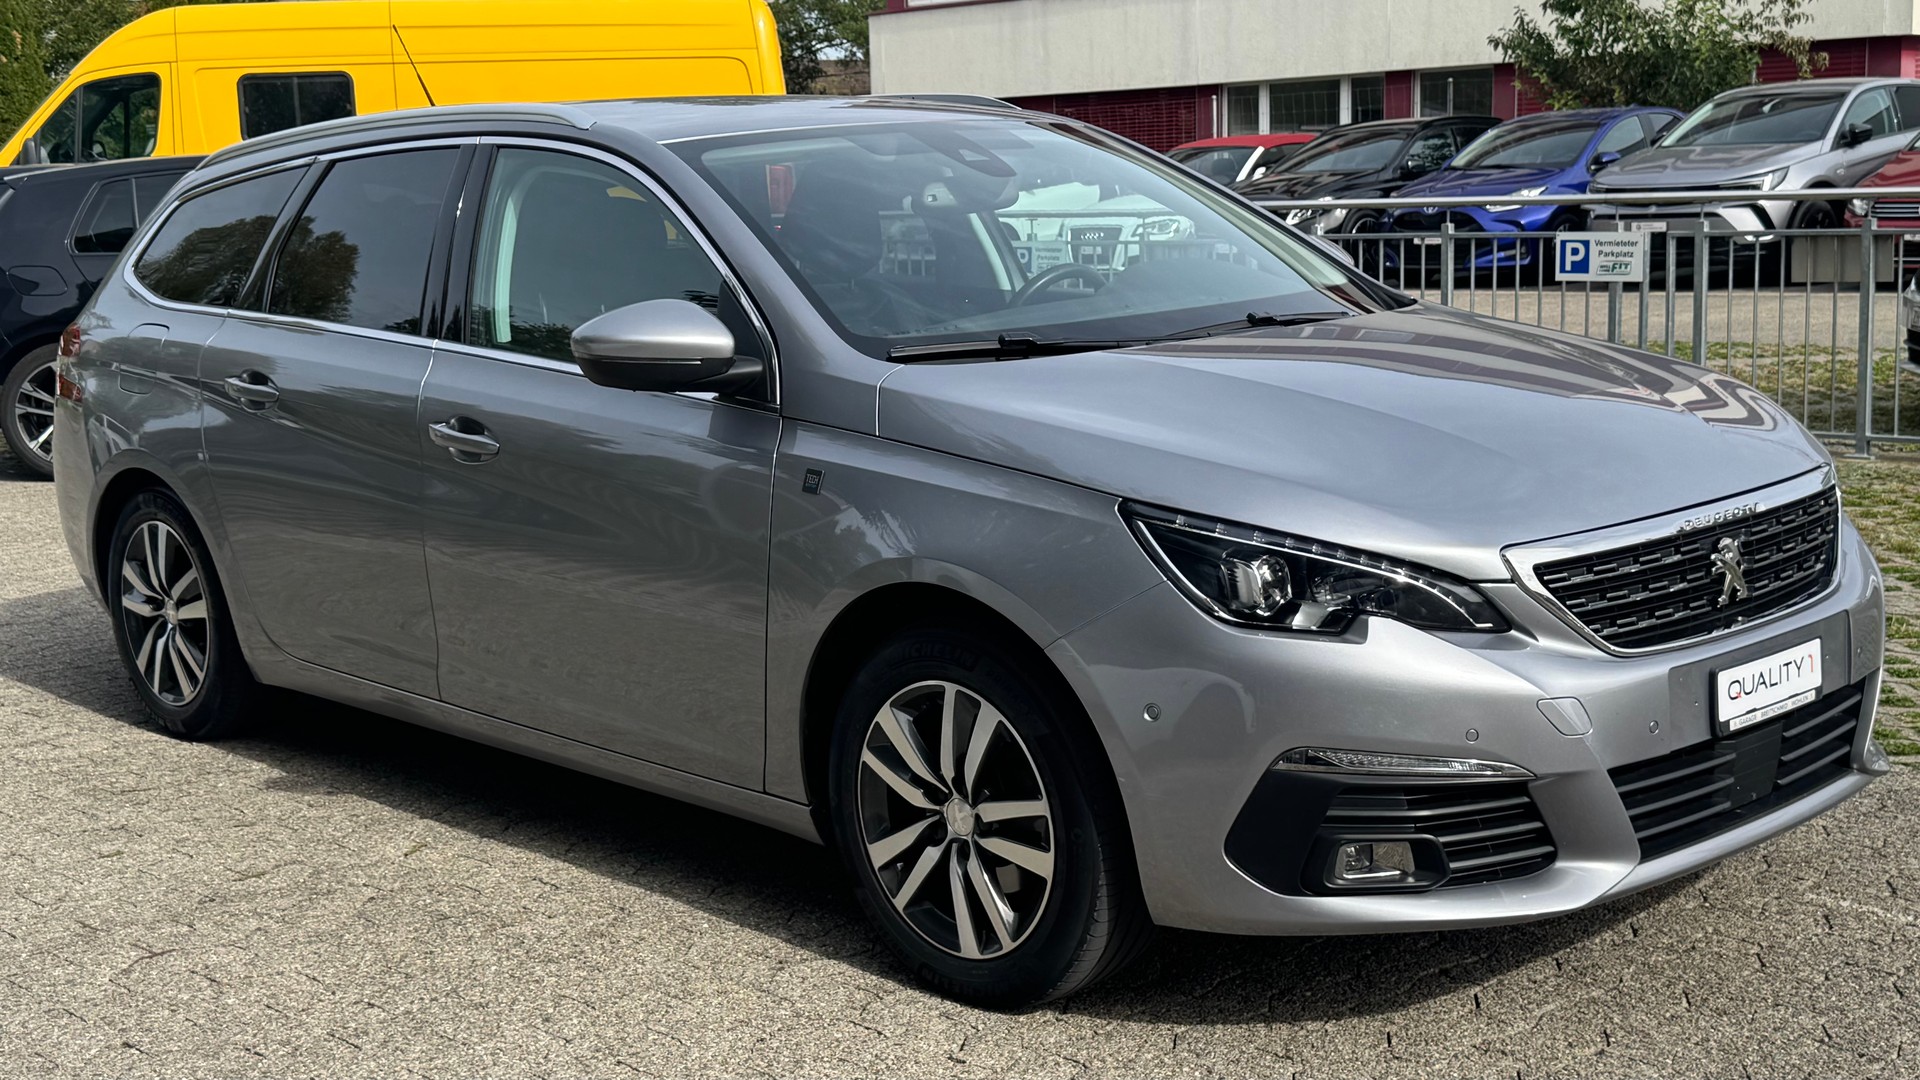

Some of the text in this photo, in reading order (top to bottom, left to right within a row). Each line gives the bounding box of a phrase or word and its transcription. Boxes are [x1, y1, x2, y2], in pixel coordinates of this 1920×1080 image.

[1564, 242, 1586, 271] P
[1598, 250, 1634, 259] Parkplatz
[1611, 262, 1630, 272] FIT
[1684, 504, 1753, 530] PEUGEOT
[1728, 653, 1814, 700] QUALITY 1
[1738, 714, 1757, 725] GARAGE
